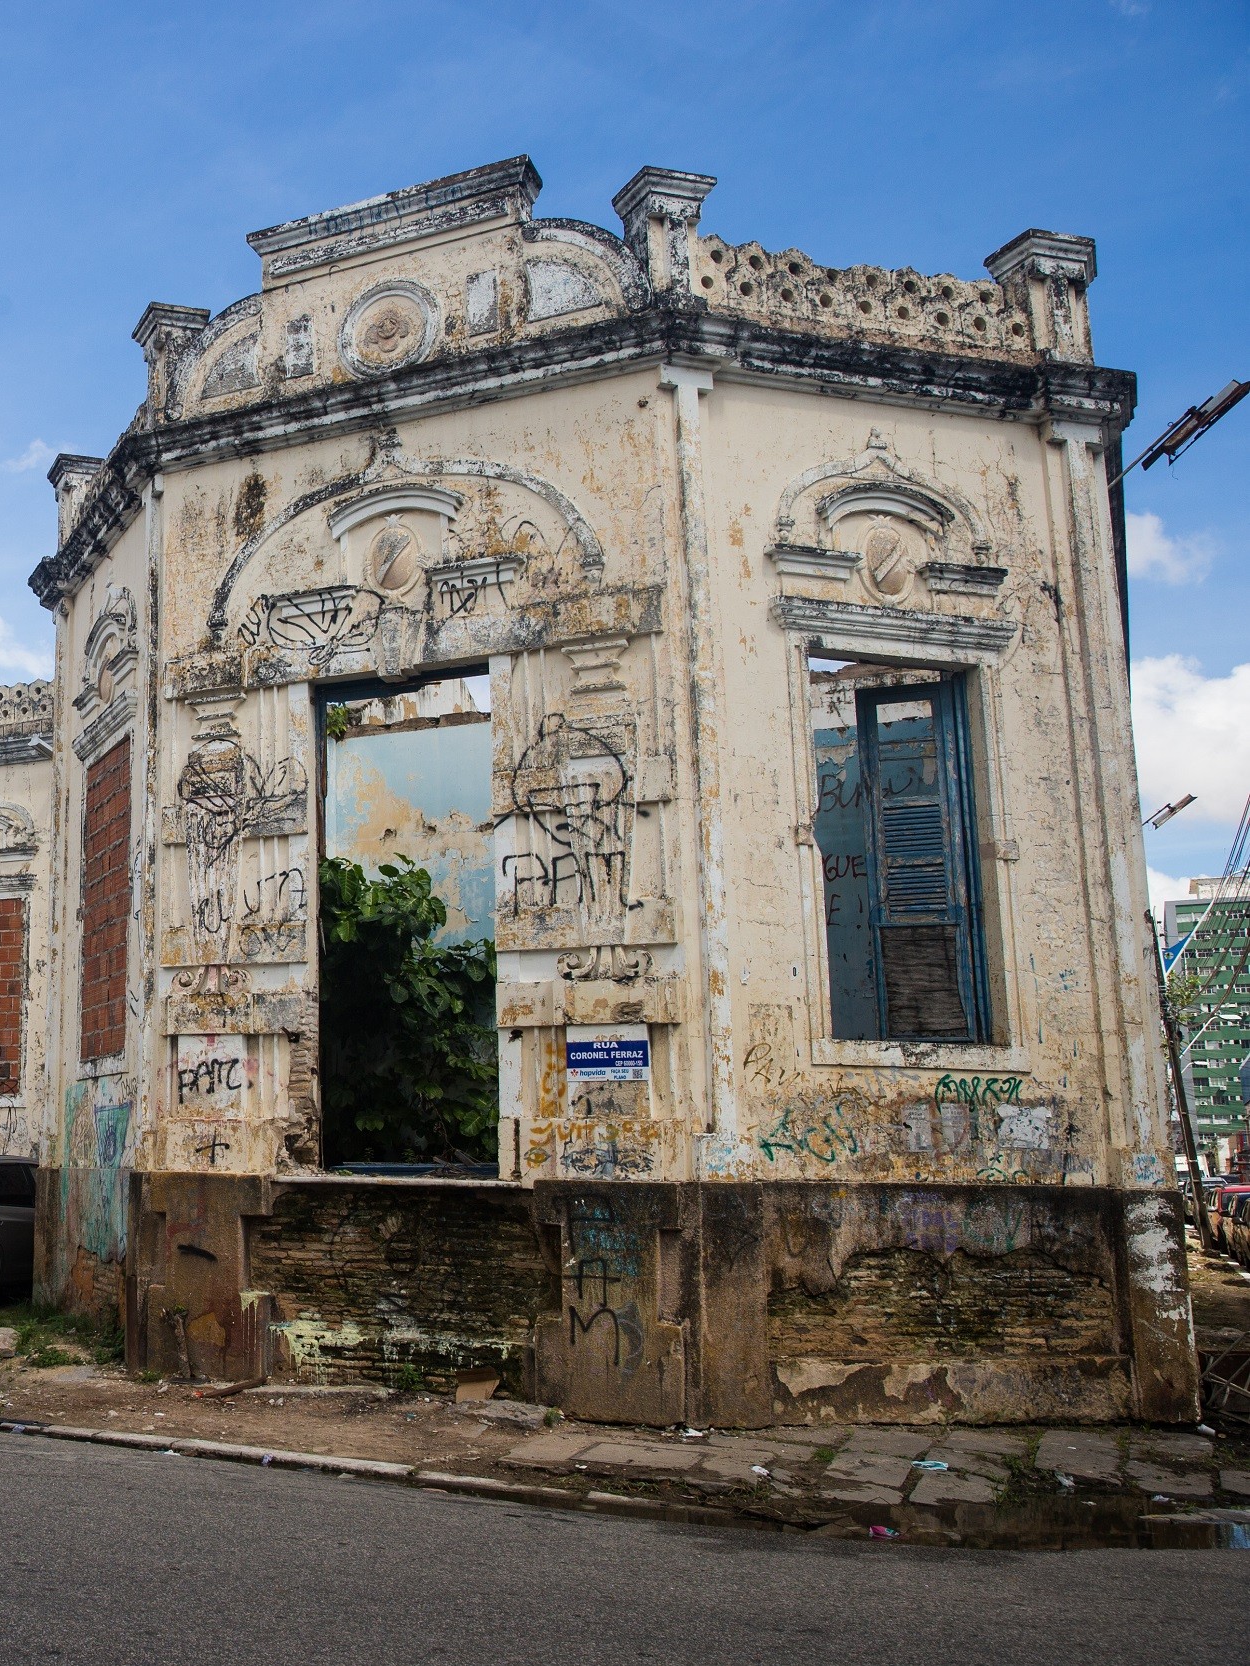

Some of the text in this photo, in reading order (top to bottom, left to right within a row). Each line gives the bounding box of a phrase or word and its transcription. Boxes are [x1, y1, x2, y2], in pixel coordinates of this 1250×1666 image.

[570, 1050, 643, 1060] CORONEL FERRAZ
[579, 1069, 606, 1077] hapvida
